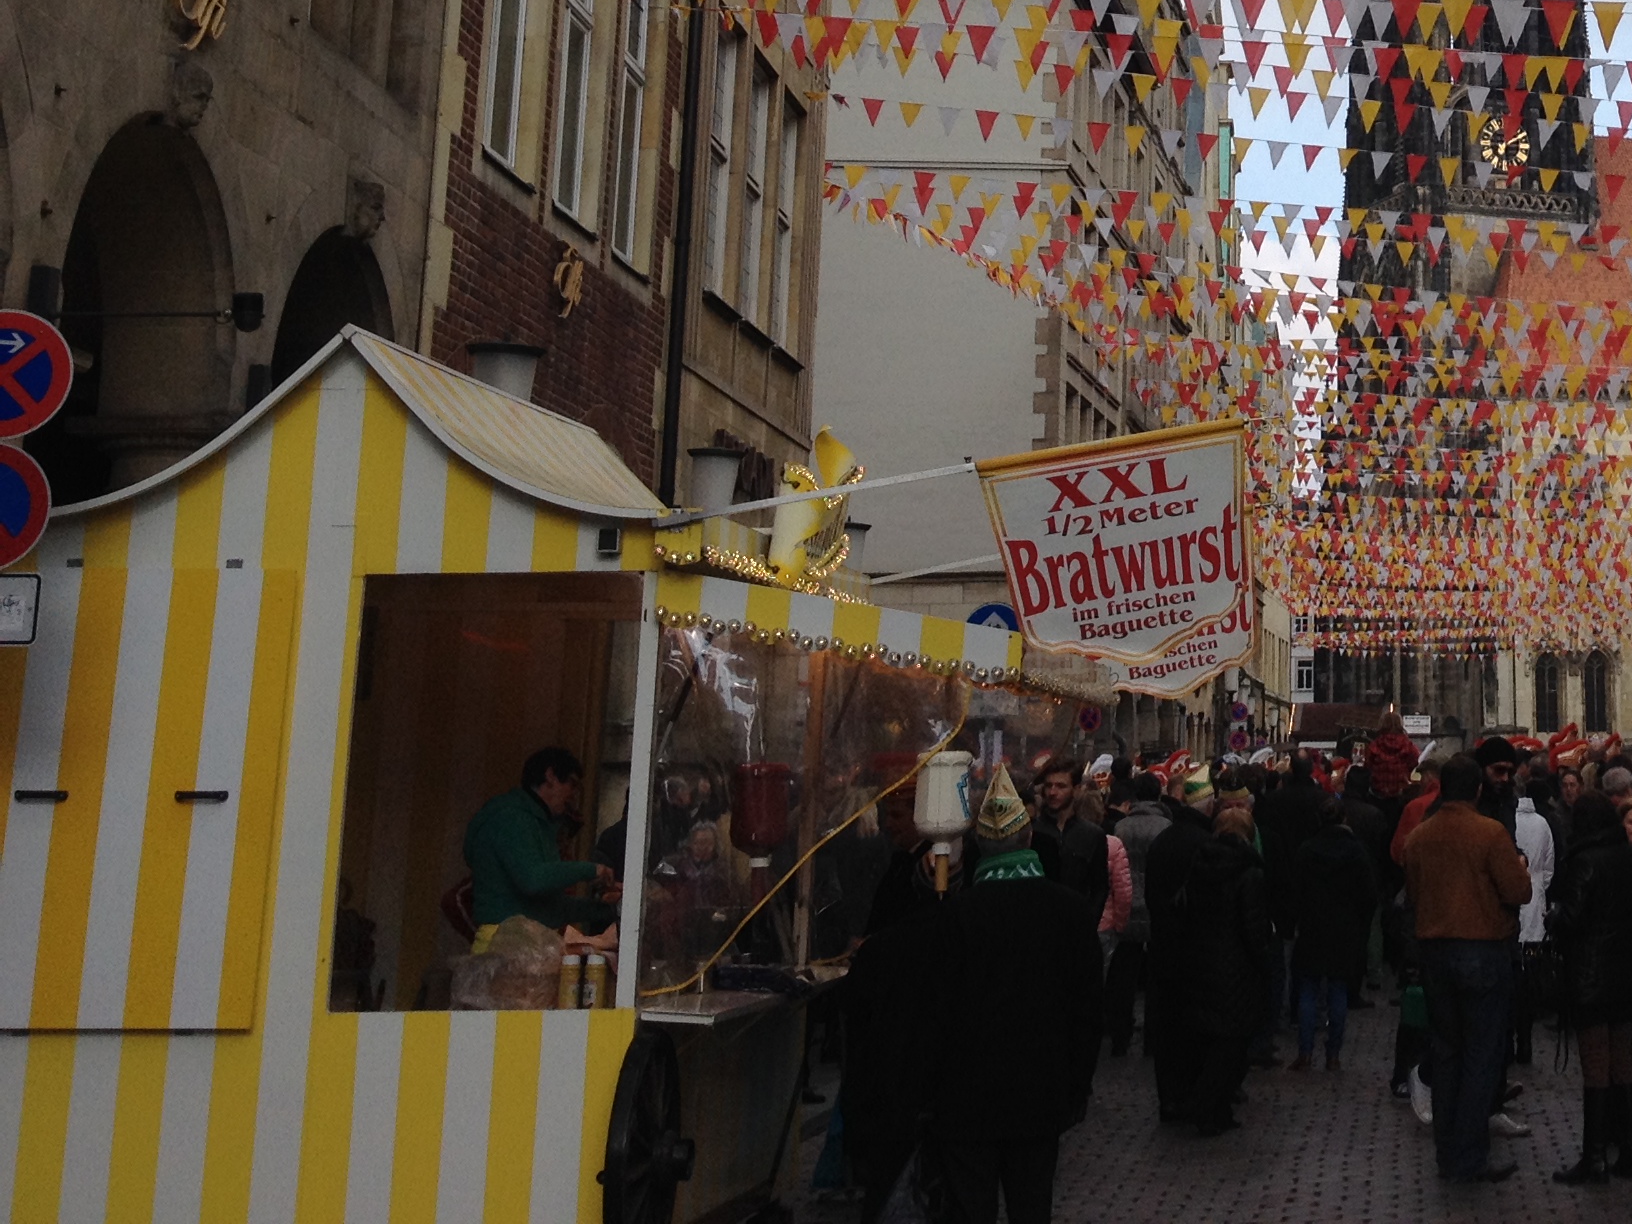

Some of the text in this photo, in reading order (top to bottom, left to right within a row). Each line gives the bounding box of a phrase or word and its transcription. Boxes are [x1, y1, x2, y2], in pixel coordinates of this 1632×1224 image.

[1046, 457, 1189, 513] XXL
[1041, 497, 1200, 537] 1/2 Meter
[1004, 501, 1241, 618] Bratwurst
[1072, 606, 1101, 624] im
[1107, 589, 1197, 619] frischen
[1079, 608, 1195, 641] Baguette
[1163, 639, 1219, 659] schen
[1128, 654, 1219, 681] Baguette
